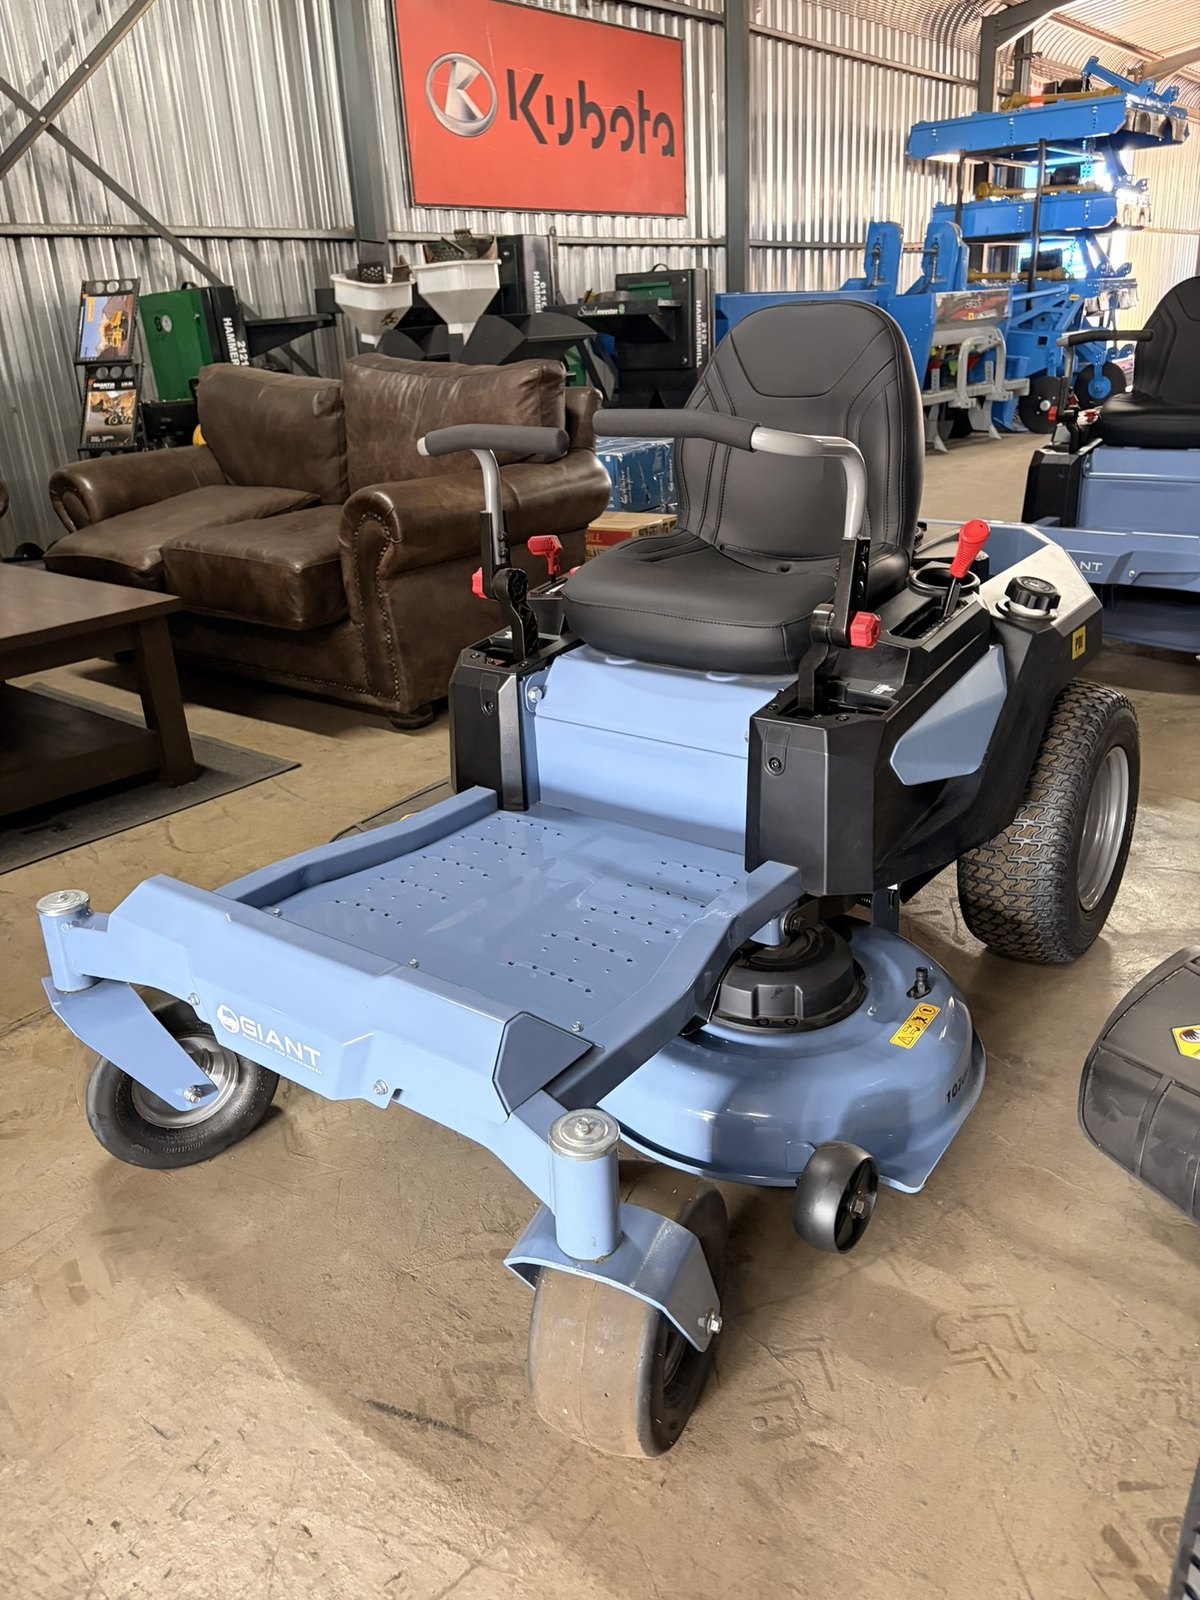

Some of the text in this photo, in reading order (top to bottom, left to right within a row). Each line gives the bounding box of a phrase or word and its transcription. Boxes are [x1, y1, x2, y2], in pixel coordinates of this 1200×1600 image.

[507, 69, 675, 157] Kubota
[223, 317, 241, 366] HAMMER
[237, 341, 250, 366] 2121
[240, 1016, 321, 1068] GIANT
